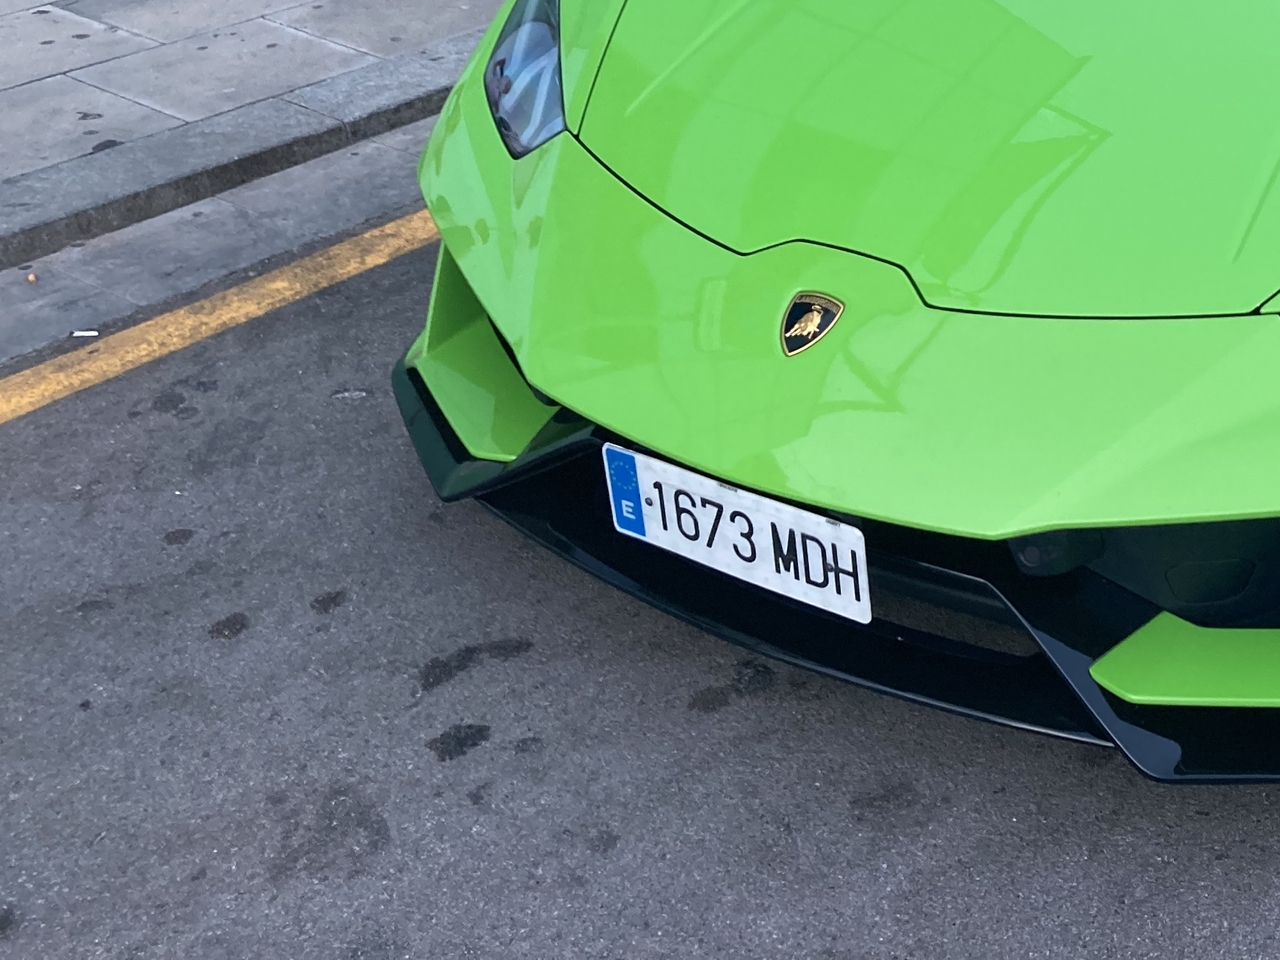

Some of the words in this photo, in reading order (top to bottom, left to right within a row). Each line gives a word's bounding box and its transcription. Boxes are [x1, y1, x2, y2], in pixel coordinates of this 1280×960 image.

[621, 499, 636, 520] E
[653, 481, 757, 564] 1673
[770, 521, 861, 602] MDH
